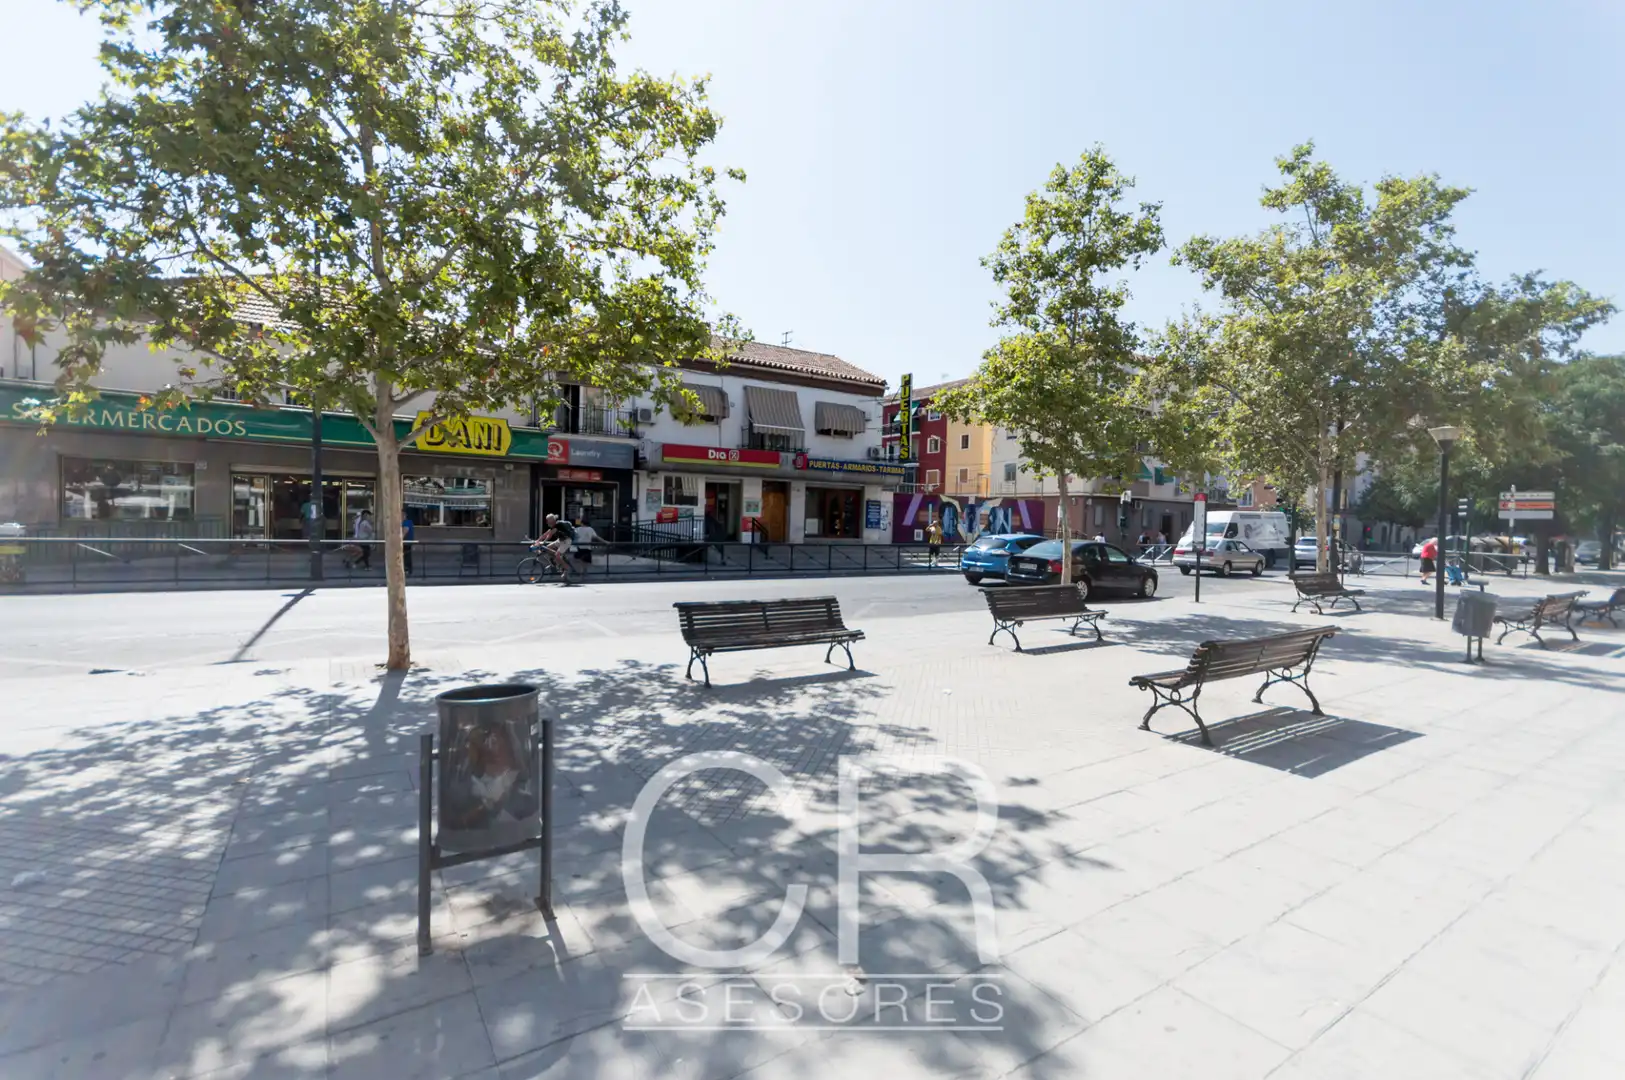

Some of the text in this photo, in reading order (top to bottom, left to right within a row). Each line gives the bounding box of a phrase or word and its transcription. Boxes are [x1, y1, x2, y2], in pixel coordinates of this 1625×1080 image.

[11, 401, 247, 437] SERMERCADOS
[899, 373, 910, 460] PUERTAS
[424, 419, 502, 451] DANI
